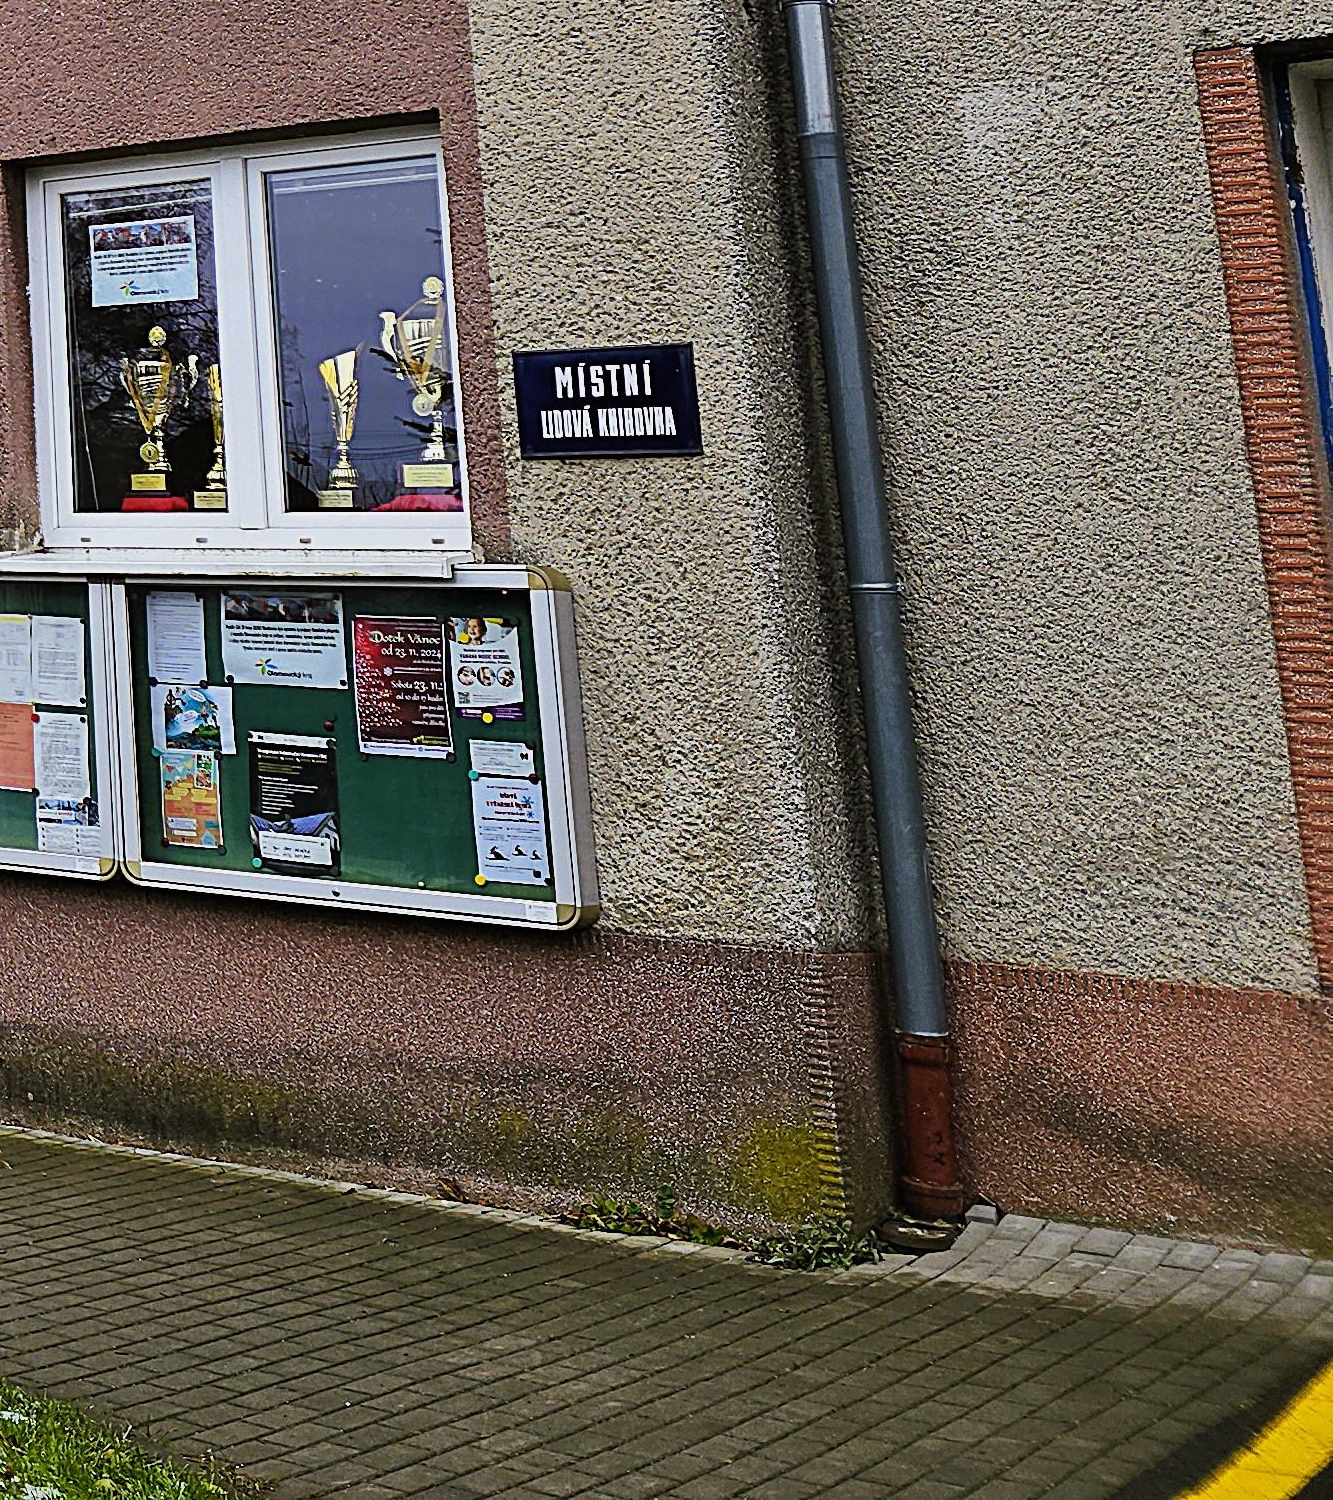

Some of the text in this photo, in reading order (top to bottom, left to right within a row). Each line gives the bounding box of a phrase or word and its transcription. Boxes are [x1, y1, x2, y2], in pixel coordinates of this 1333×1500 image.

[554, 359, 652, 399] MÍSTNÍ
[540, 405, 677, 439] LIDOVÁ KNIHOVNA
[369, 630, 405, 644] Dotek
[381, 644, 393, 655] od
[420, 649, 442, 659] 2024
